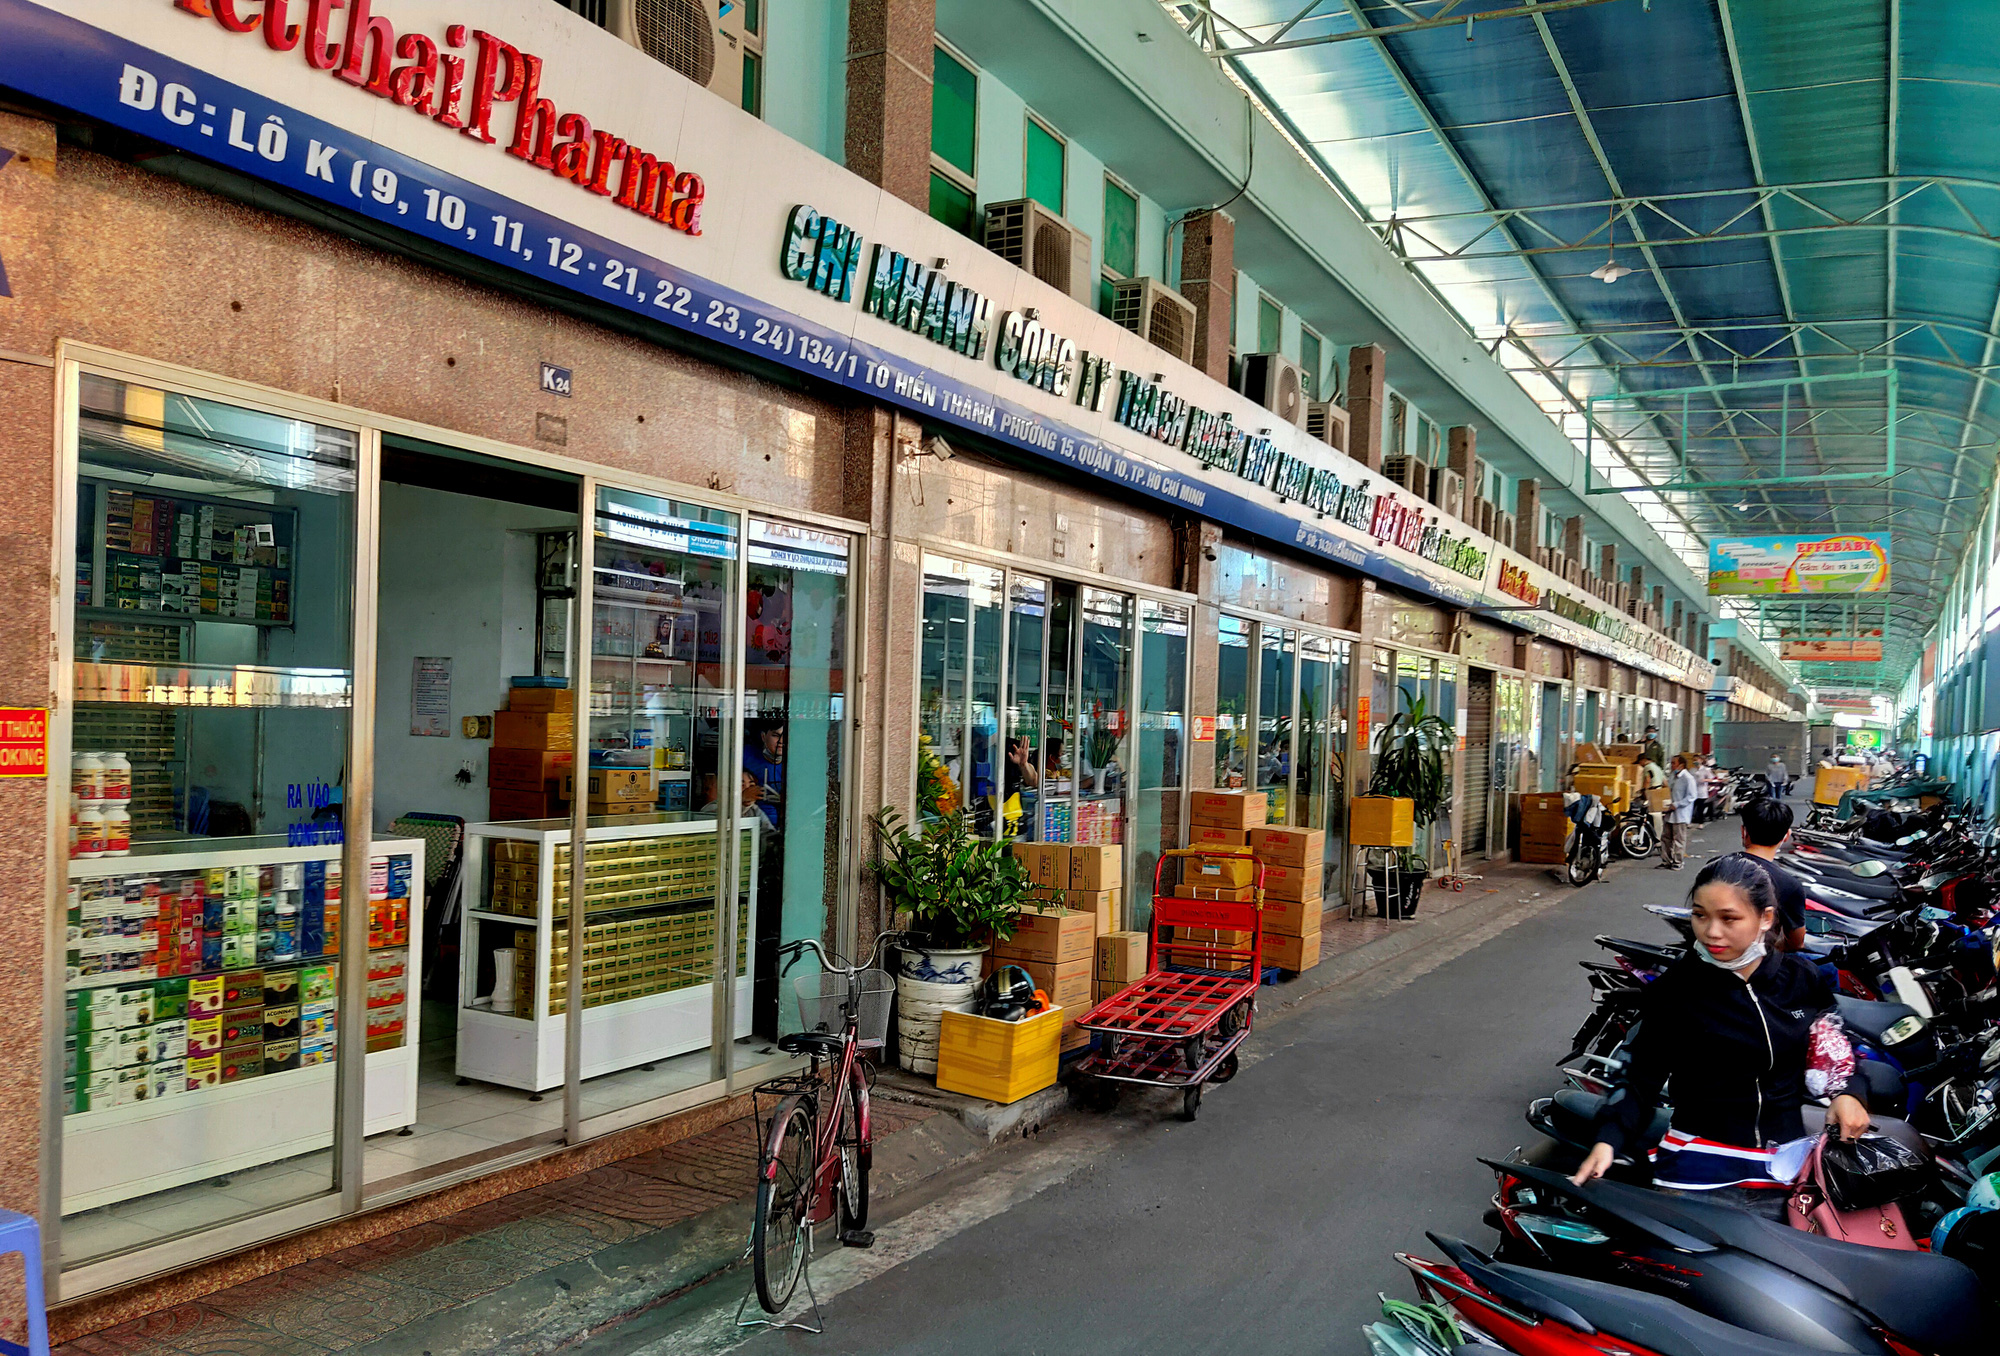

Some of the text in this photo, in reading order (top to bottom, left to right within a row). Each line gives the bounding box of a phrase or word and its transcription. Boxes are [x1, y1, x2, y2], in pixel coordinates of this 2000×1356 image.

[119, 63, 216, 137] ĐC:
[228, 108, 288, 162] LÔ
[305, 139, 339, 184] K
[350, 160, 409, 215] (9,
[423, 188, 477, 241] 10,
[491, 215, 533, 261] 11,
[653, 280, 699, 323] 22,
[705, 300, 747, 340] 23,
[752, 319, 795, 355] 24)
[799, 336, 857, 378] 134/1
[866, 360, 890, 389] TÔ
[942, 389, 997, 432] THÀNH,
[1061, 437, 1076, 461] 15,
[1114, 458, 1129, 482] 10,
[1180, 484, 1206, 508] MINH
[780, 204, 864, 304] CHI
[862, 243, 996, 361] NHÁNH
[994, 307, 1076, 398] CÔNG
[1075, 350, 1116, 413] TY
[543, 366, 570, 393] K24
[1796, 541, 1876, 552] EFFEBABY
[287, 776, 330, 808] RA VÀO
